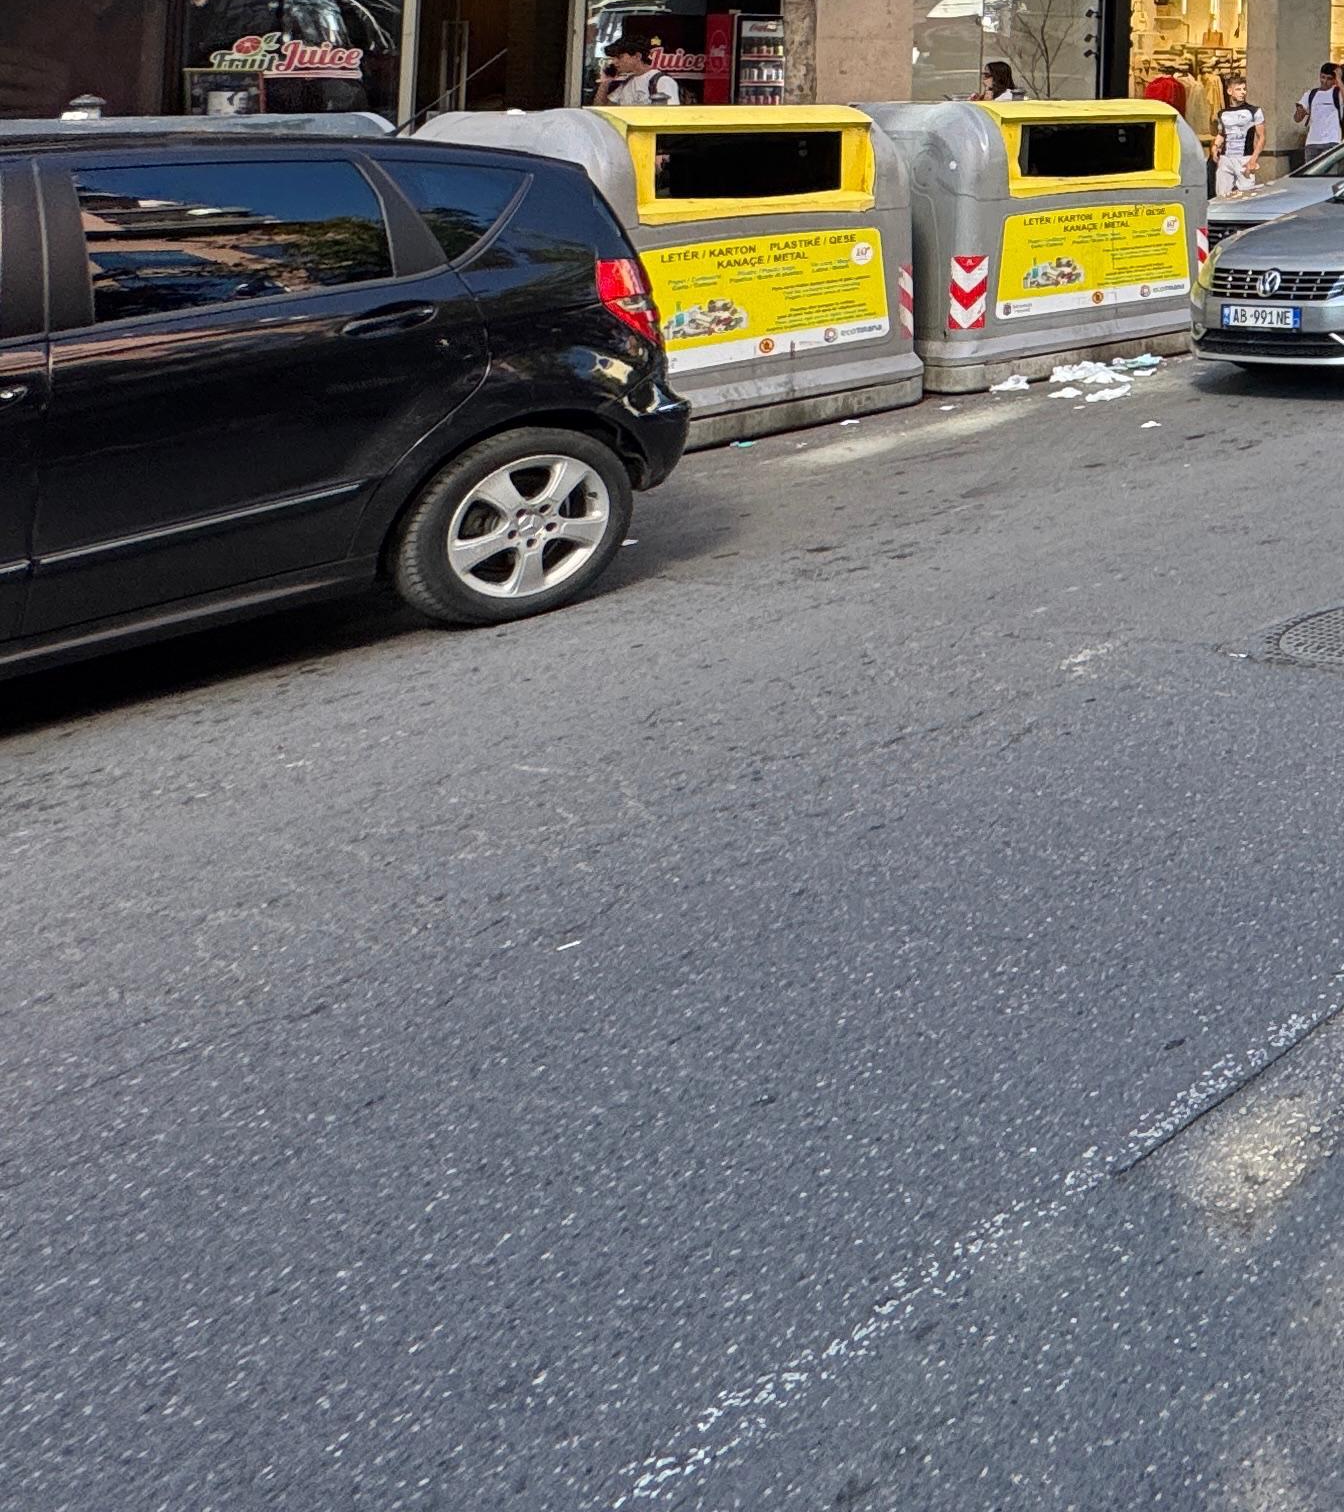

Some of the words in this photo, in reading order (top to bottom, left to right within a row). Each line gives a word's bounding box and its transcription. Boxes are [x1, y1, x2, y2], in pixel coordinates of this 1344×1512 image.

[275, 41, 363, 72] Juice
[649, 47, 706, 72] Juice
[709, 245, 757, 258] KARTON
[1232, 308, 1248, 324] AB
[1253, 309, 1291, 326] 991NE
